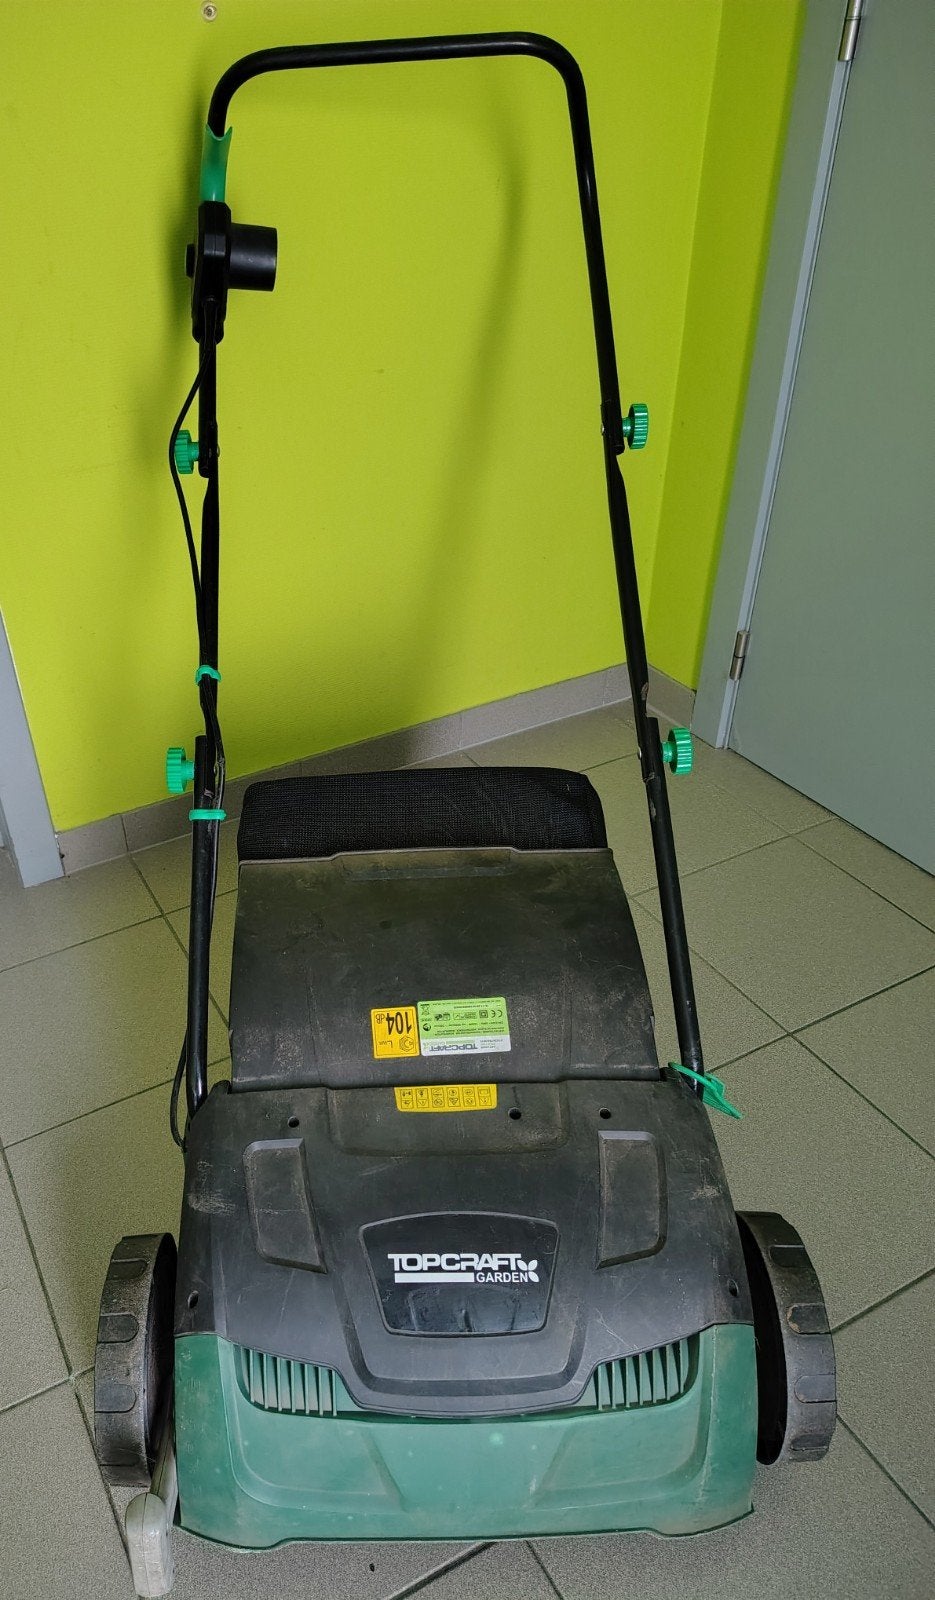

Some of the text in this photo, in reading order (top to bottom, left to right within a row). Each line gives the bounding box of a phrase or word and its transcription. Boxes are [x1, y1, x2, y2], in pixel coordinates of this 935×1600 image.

[375, 1011, 412, 1035] 104 dB
[429, 1043, 478, 1051] TOPCRAFT
[387, 1253, 522, 1271] TOPCRAFT
[476, 1272, 528, 1283] GARDEN
